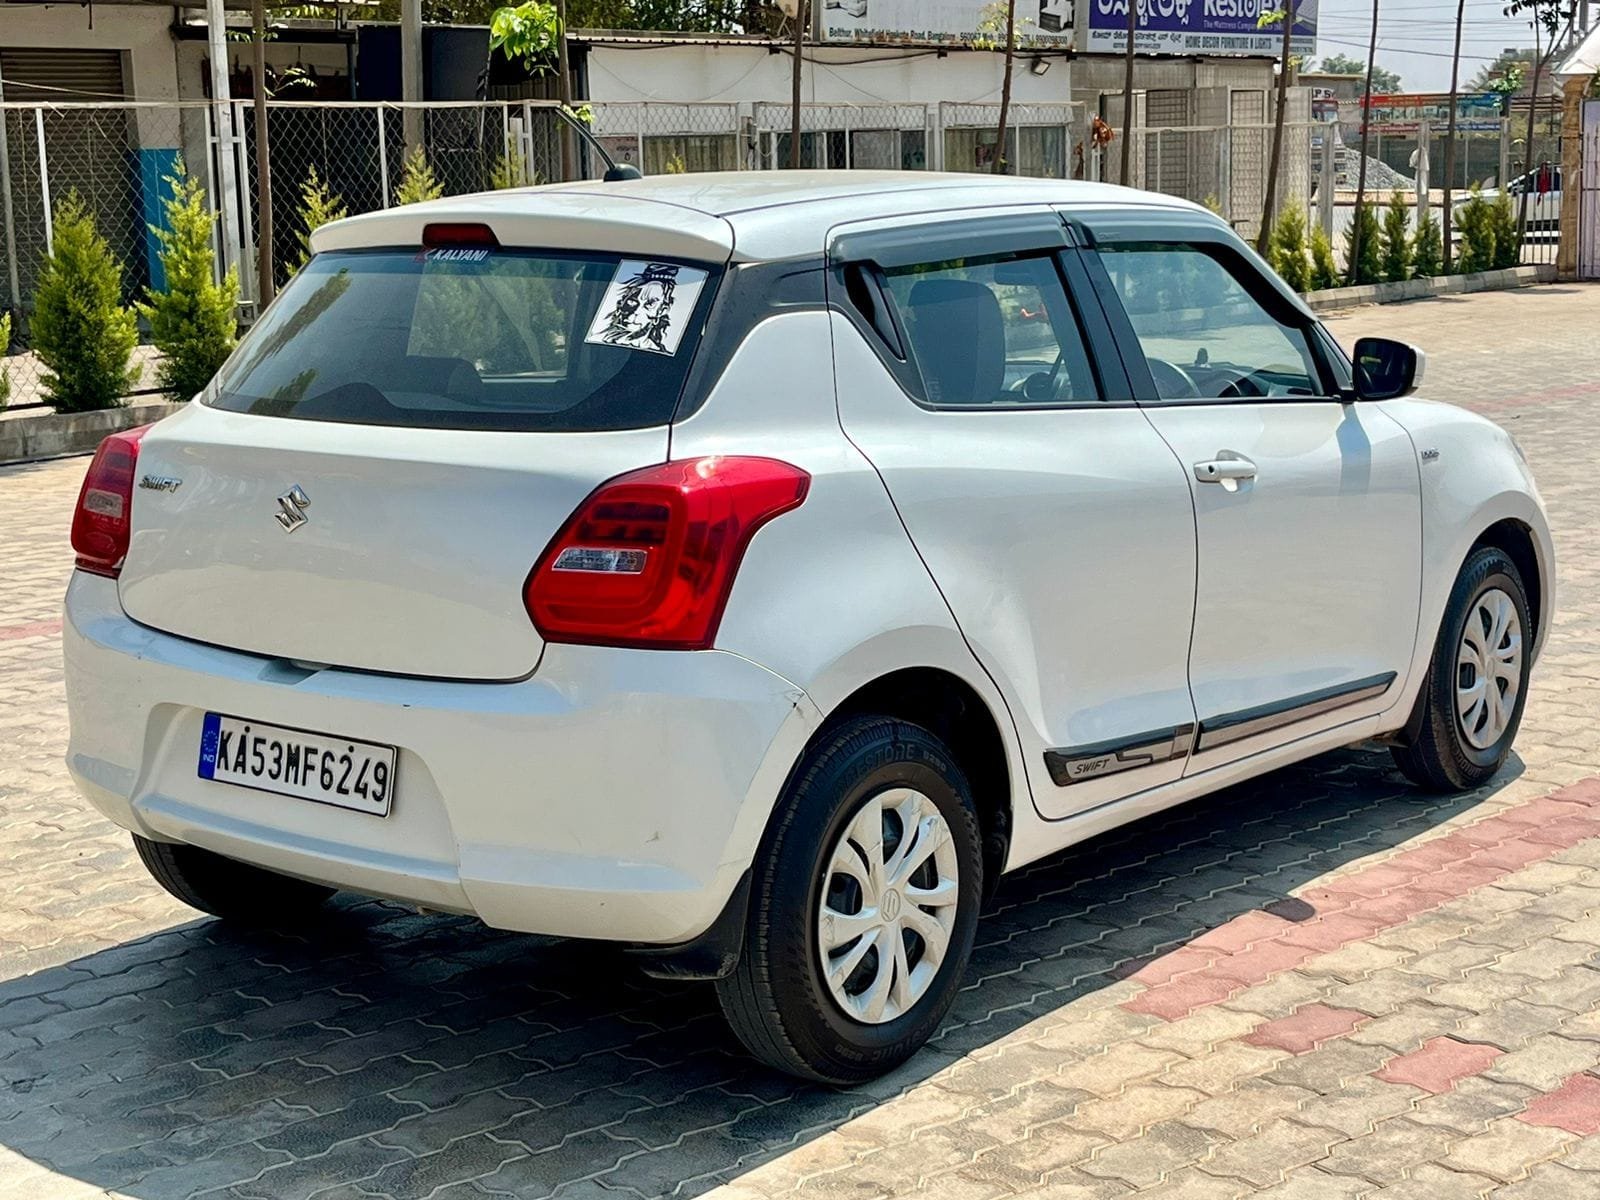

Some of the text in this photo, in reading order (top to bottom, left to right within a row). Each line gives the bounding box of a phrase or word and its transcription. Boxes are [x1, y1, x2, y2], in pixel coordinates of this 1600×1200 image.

[1221, 36, 1248, 49] FURNITURE
[433, 249, 488, 262] KALYANI
[139, 475, 182, 494] SWIFT
[203, 753, 215, 763] IND
[216, 729, 388, 803] KA53MF6249
[1073, 758, 1110, 775] SWIFT
